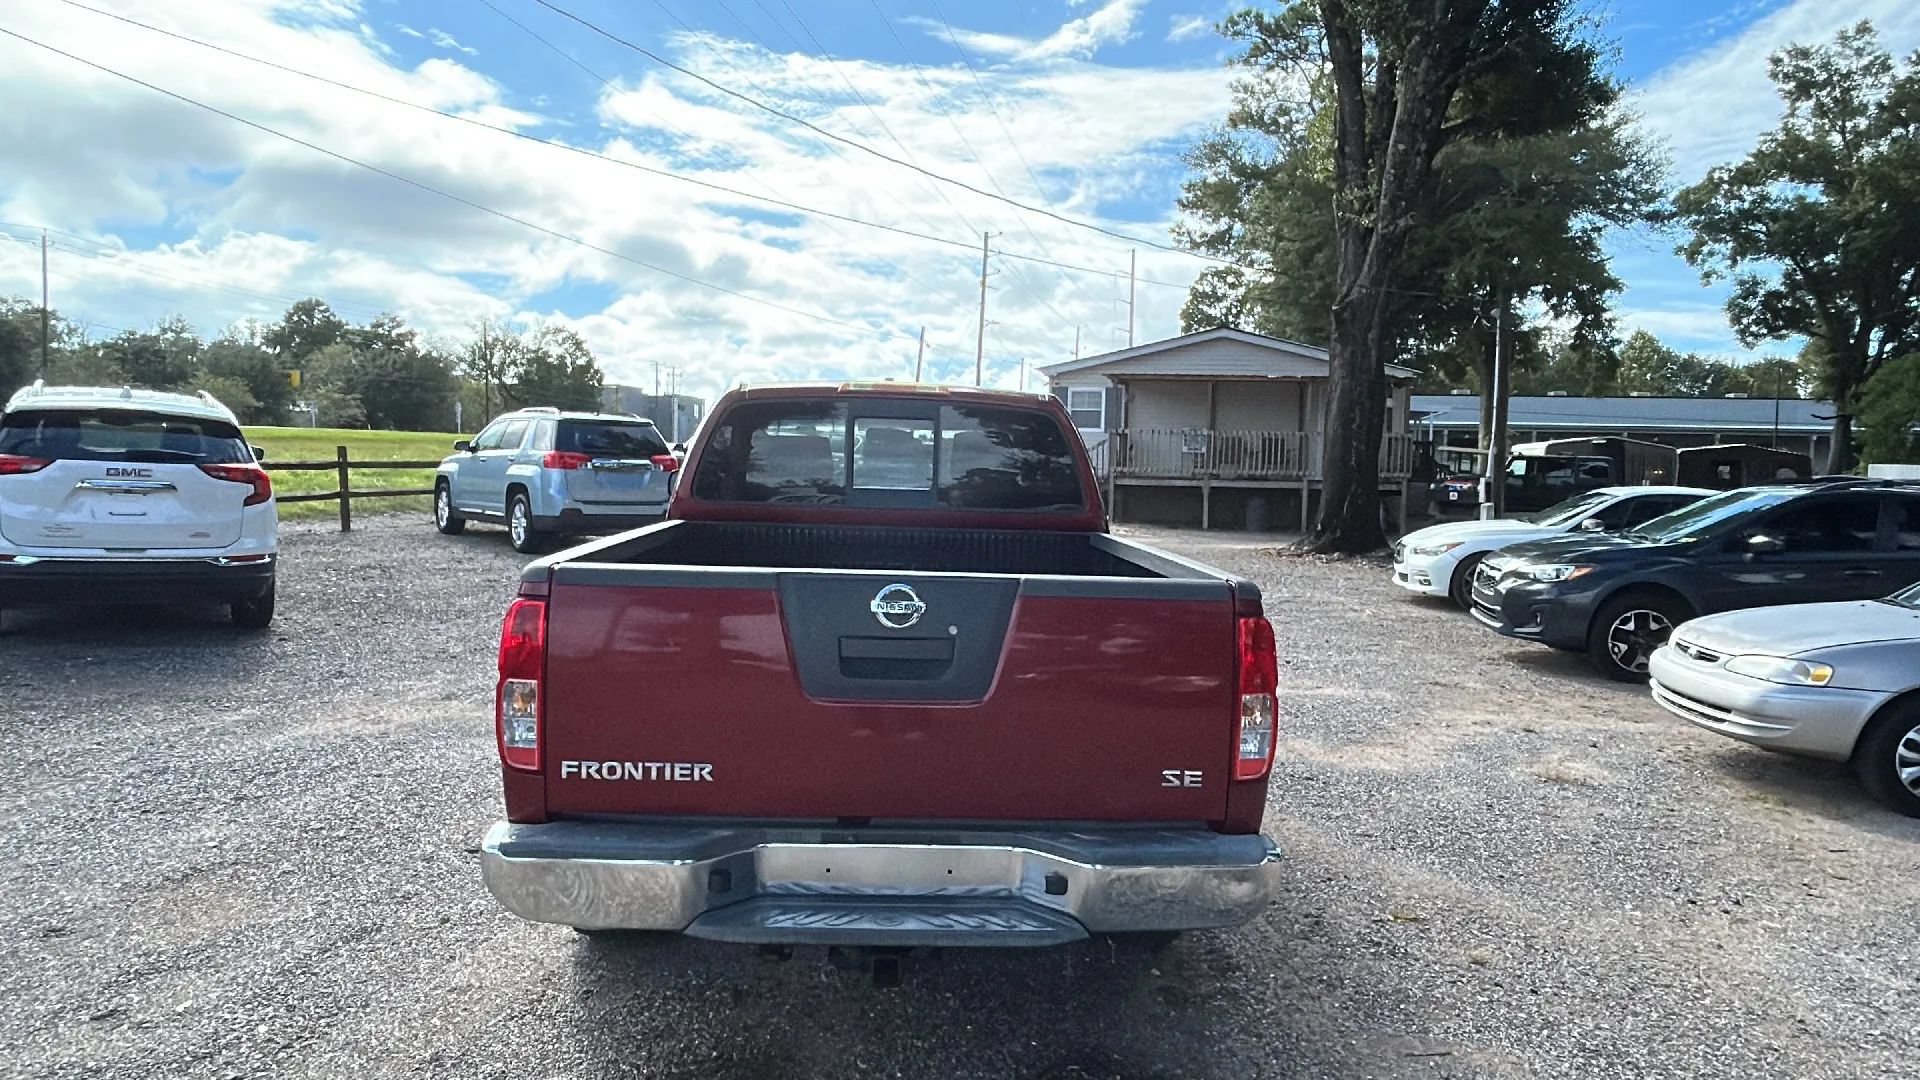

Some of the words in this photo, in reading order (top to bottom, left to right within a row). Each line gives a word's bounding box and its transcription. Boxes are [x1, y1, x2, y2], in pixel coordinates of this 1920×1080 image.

[105, 467, 153, 478] GMC
[876, 602, 920, 613] NISSAN
[560, 760, 714, 782] FRONTIER
[1161, 769, 1203, 787] SE
